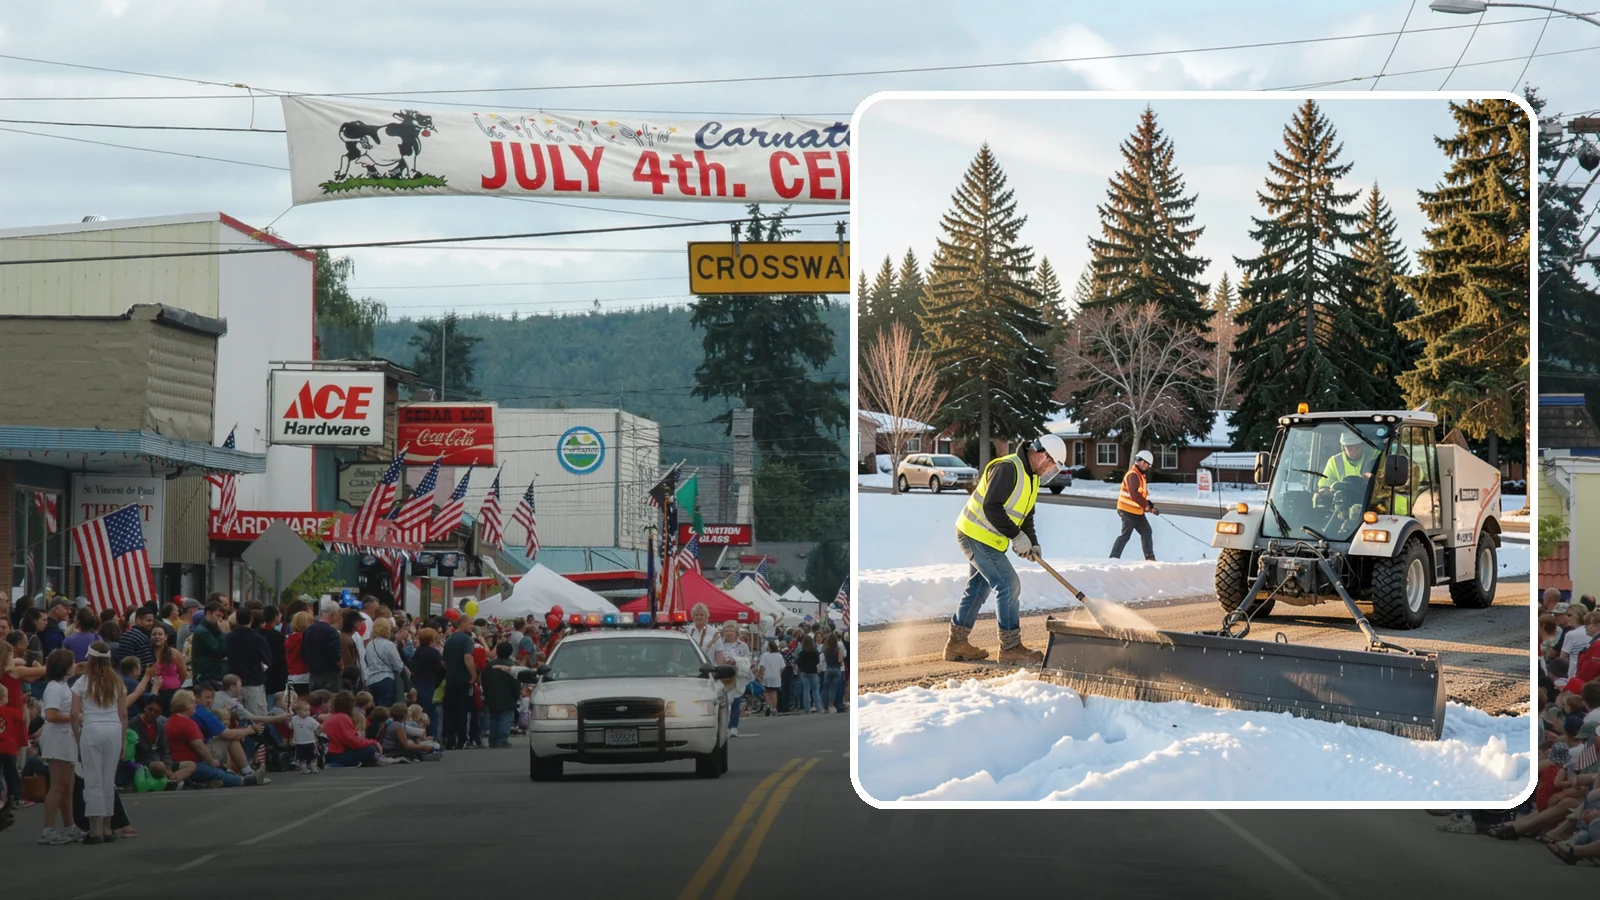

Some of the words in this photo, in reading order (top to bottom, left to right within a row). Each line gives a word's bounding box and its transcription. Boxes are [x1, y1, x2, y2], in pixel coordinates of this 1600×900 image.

[695, 121, 850, 150] Carnat
[481, 141, 605, 192] JULY
[632, 150, 746, 197] 4th.
[696, 254, 850, 280] CROSSWA
[282, 379, 373, 420] ACE
[406, 409, 452, 422] CEDAR
[283, 421, 371, 436] Hardware
[416, 428, 477, 447] Coca-Cola
[353, 467, 385, 480] Simpl
[95, 485, 124, 495] Vincent
[126, 486, 136, 495] de
[138, 486, 155, 495] Paul
[81, 503, 154, 522] THT
[212, 516, 331, 536] HARDARE
[688, 526, 741, 535] CRNATION
[699, 535, 730, 543] GLASS
